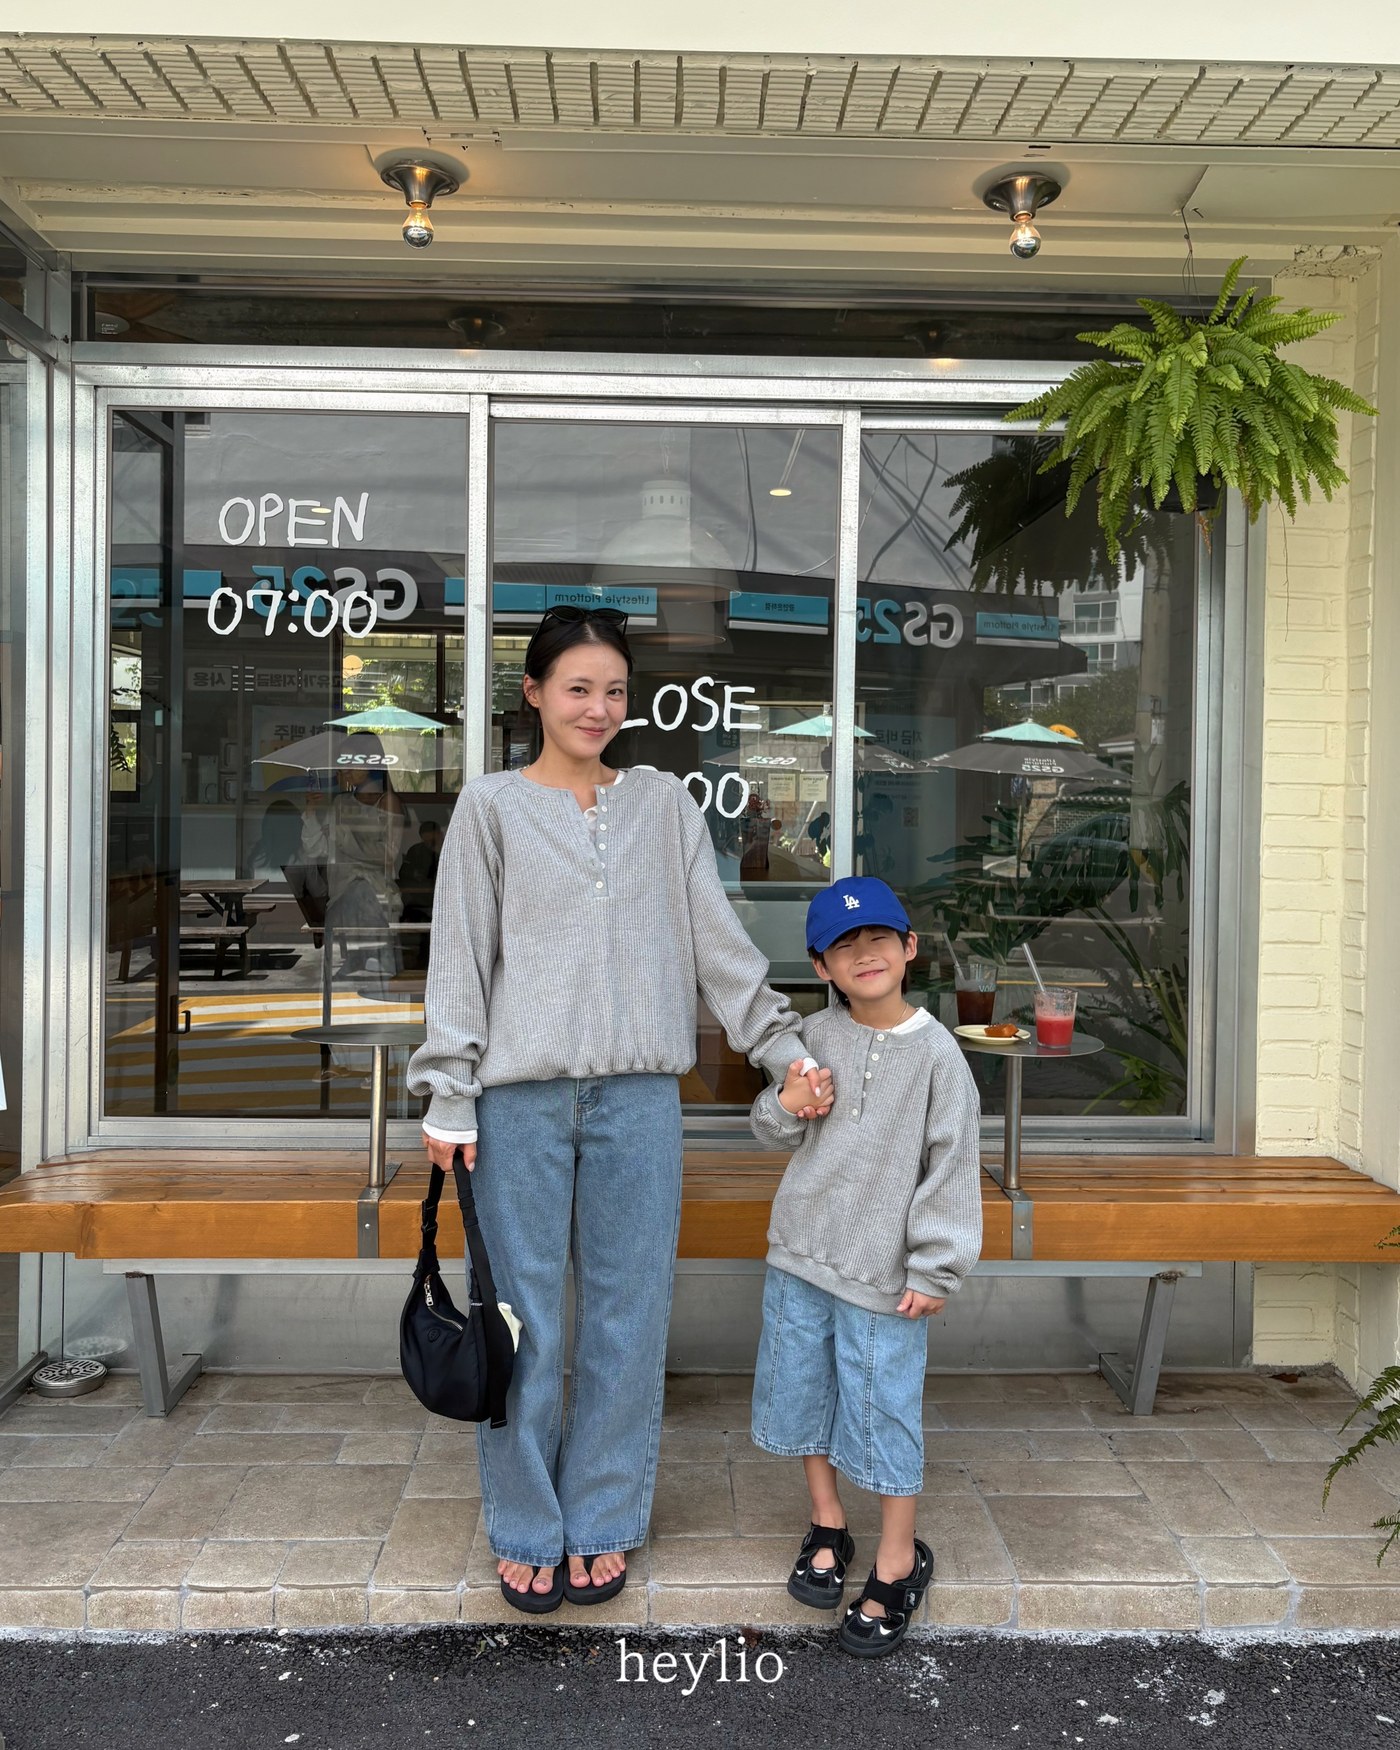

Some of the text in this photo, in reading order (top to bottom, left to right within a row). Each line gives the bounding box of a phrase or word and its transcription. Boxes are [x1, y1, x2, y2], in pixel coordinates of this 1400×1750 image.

[218, 492, 369, 547] OPEN
[207, 586, 378, 639] 07:00
[843, 894, 861, 910] LA
